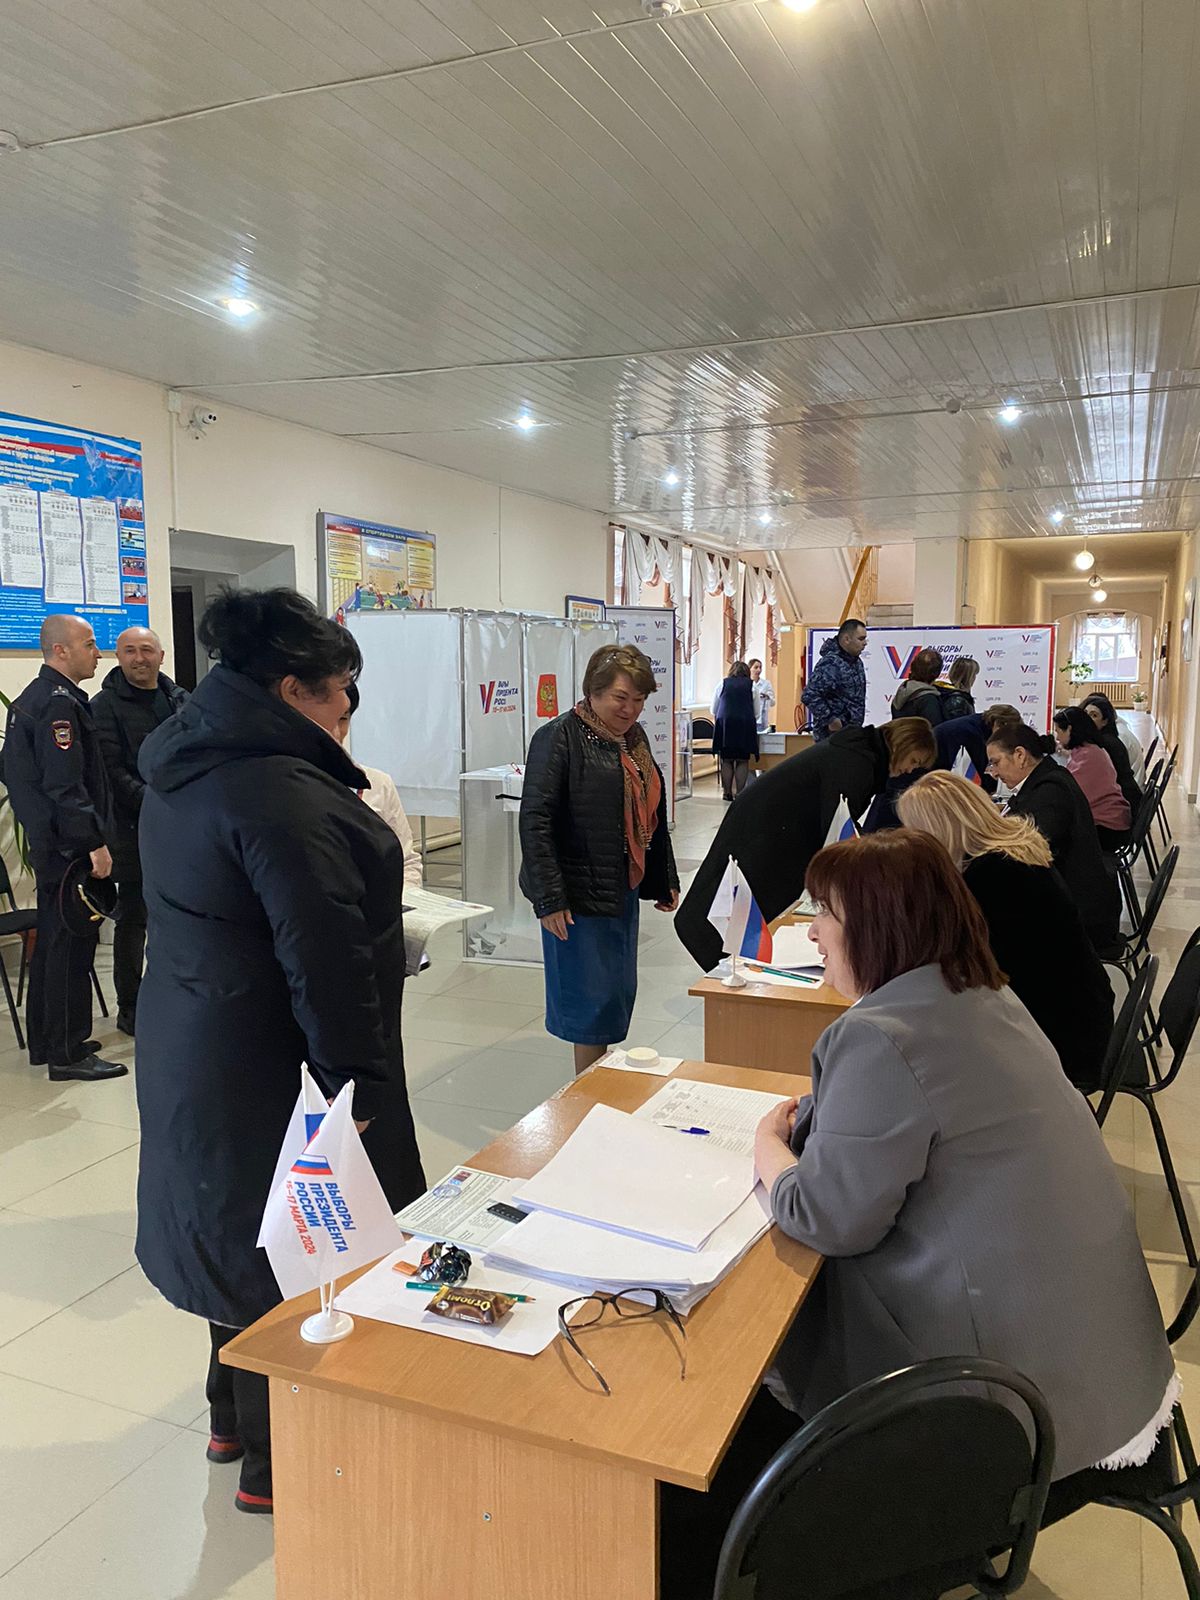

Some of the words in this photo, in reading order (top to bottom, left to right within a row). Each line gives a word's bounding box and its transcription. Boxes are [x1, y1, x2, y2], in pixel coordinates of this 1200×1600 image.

[294, 1181, 321, 1227] РОССИИ
[308, 1182, 349, 1253] ПРЕЗИДЕНТА
[325, 1182, 356, 1230] ВЫБОРЫ
[290, 1205, 308, 1234] МАРТА
[300, 1234, 317, 1255] 2024
